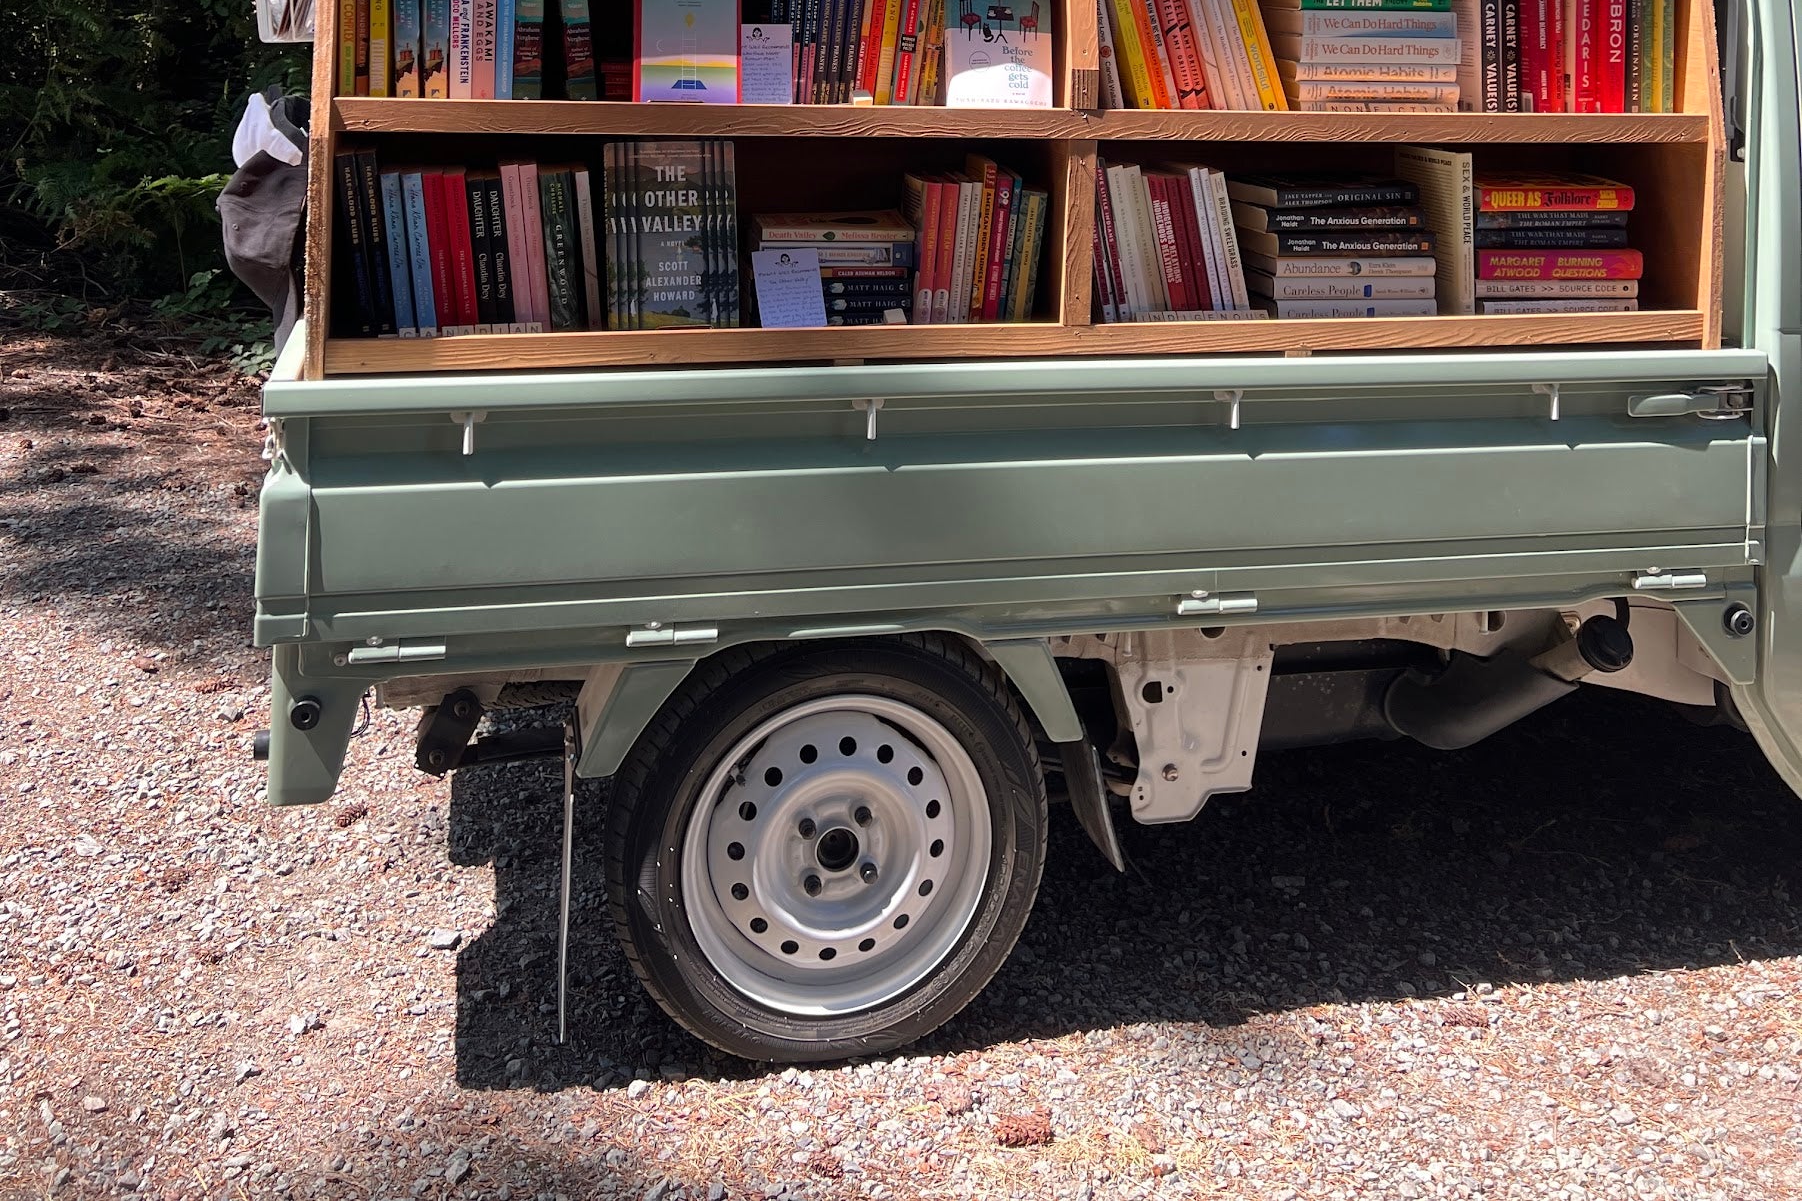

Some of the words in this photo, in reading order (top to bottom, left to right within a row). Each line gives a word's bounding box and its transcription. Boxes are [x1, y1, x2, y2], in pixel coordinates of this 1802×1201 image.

[476, 4, 484, 27] AND
[1162, 0, 1178, 24] TELL
[1174, 0, 1189, 24] TELL
[343, 3, 353, 46] COMPLEX
[1324, 19, 1340, 29] We
[1341, 19, 1360, 29] Can
[1363, 19, 1377, 29] Do
[1378, 19, 1403, 29] Hard
[1405, 19, 1437, 31] Things
[1485, 3, 1496, 48] CARNEY
[1505, 3, 1517, 48] CARNEY
[460, 23, 469, 84] FRANKENSTEIN
[1002, 46, 1033, 57] Before
[1010, 55, 1026, 65] the
[1172, 34, 1181, 51] AMY
[1177, 54, 1190, 87] GRIFFIN
[1183, 34, 1191, 51] AMY
[1188, 54, 1200, 87] GRIFFIN
[1322, 44, 1340, 55] We
[1341, 44, 1360, 55] Can
[1362, 44, 1377, 55] Do
[1378, 44, 1404, 55] Hard
[1405, 44, 1439, 58] Things
[1004, 64, 1033, 73] coffee
[1250, 43, 1270, 91] wordslut
[1323, 66, 1375, 77] Atomic
[1379, 66, 1424, 77] Habits
[1008, 72, 1029, 82] gets
[1008, 79, 1029, 89] cold
[655, 165, 687, 182] THE
[1462, 162, 1470, 183] SEX
[366, 165, 376, 216] HALF-BLOOD
[644, 190, 698, 207] OTHER
[1491, 191, 1525, 208] QUEER
[1527, 191, 1541, 207] AS
[1543, 191, 1591, 208] Folklore
[345, 166, 356, 217] HALF-BLOOD
[351, 219, 359, 245] BLUES
[472, 190, 485, 238] DAUGHTER
[489, 190, 501, 237] DAUGHTER
[982, 192, 992, 230] AMERICAN
[1463, 195, 1471, 221] WORLD
[641, 215, 702, 232] VALLEY
[1310, 216, 1325, 225] The
[1327, 216, 1359, 225] Anxious
[1361, 216, 1406, 225] Generation
[793, 232, 817, 240] Valley
[980, 231, 988, 252] BORN
[1153, 199, 1165, 244] INDIGENOUS
[1161, 244, 1174, 284] RELATIONS
[1218, 196, 1230, 226] BRAIDING
[1224, 227, 1238, 269] SWEETGRASS
[1463, 223, 1472, 245] PEACE
[1161, 201, 1175, 245] INDIGENOUS
[1168, 245, 1182, 284] RELATIONS
[1322, 241, 1337, 249] The
[1339, 241, 1371, 250] Anxious
[1372, 242, 1418, 251] Generation
[478, 253, 489, 286] Claudia
[495, 252, 506, 284] Claudia
[555, 224, 568, 305] GREENWOOD
[658, 261, 688, 271] SCOTT
[976, 253, 985, 283] CHINESE
[1283, 263, 1341, 274] Abundance
[1489, 256, 1546, 266] MARGARET
[1557, 257, 1603, 266] BURNING
[645, 276, 702, 287] ALEXANDER
[1493, 268, 1540, 277] ATWOOD
[1552, 269, 1607, 278] QUESTIONS
[481, 286, 491, 300] Dey
[498, 285, 507, 299] Dey
[653, 291, 695, 301] HOWARD
[1283, 285, 1325, 295] Careless
[1328, 284, 1361, 298] People
